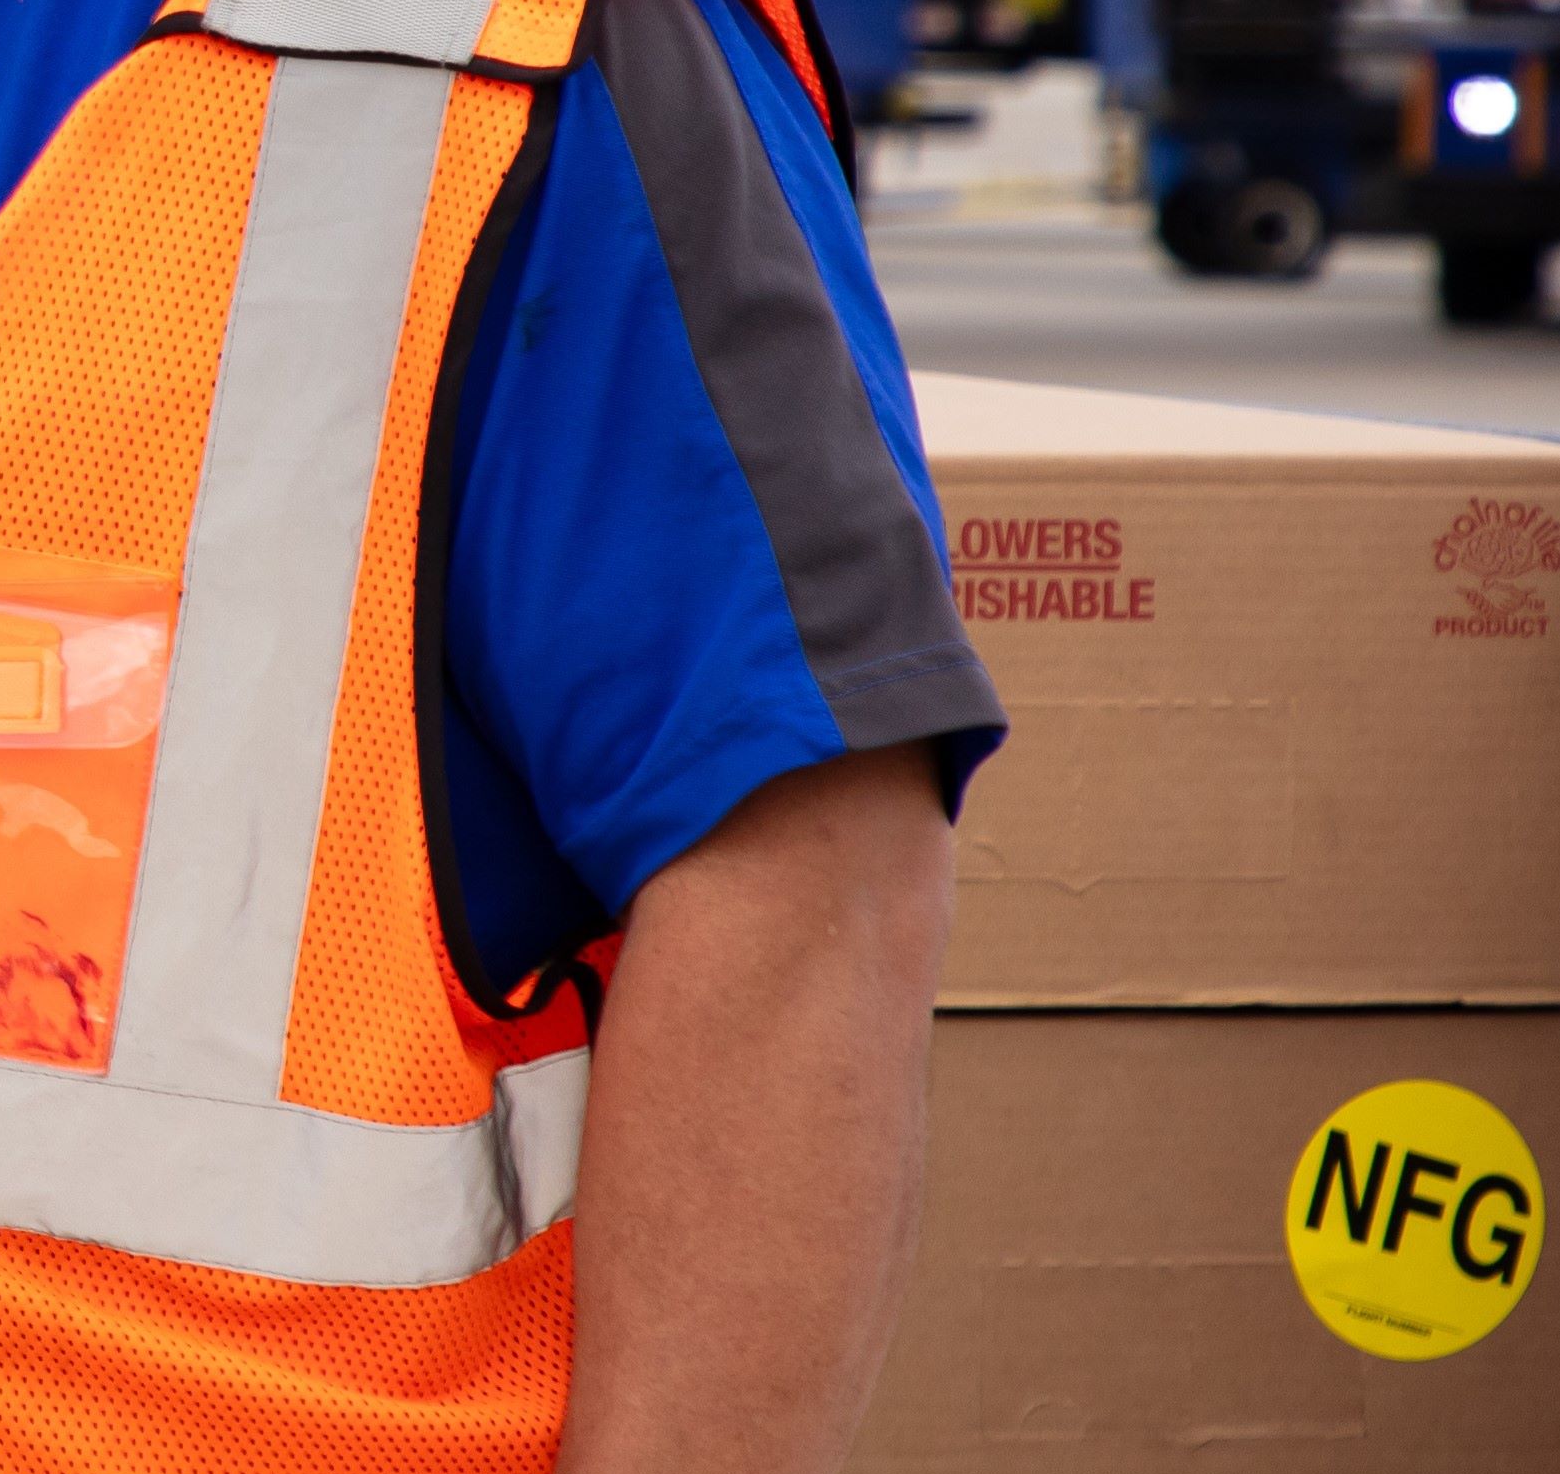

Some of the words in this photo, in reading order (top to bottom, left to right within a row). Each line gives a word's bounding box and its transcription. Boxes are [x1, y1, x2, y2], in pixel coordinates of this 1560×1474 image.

[950, 515, 1125, 563] OWERS
[951, 575, 1157, 625] ISHABLE
[1431, 612, 1551, 641] PRODUCT
[1303, 1129, 1533, 1289] NFG
